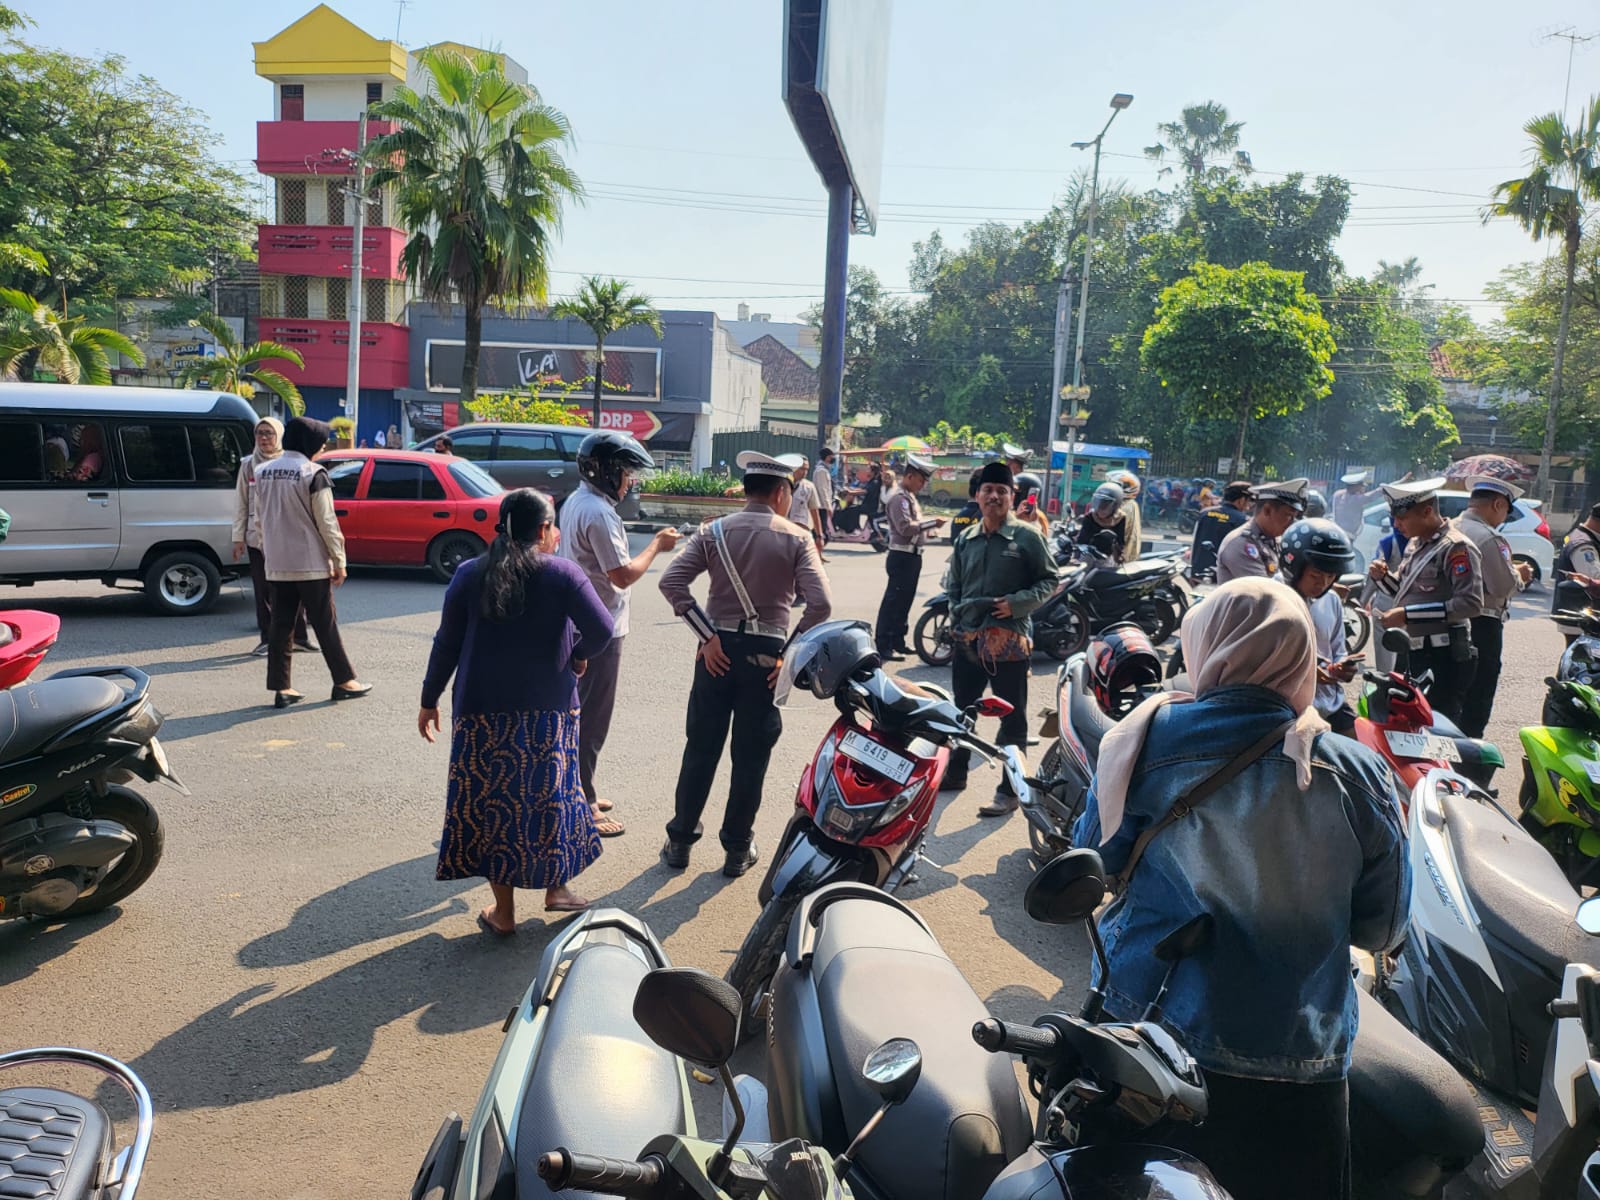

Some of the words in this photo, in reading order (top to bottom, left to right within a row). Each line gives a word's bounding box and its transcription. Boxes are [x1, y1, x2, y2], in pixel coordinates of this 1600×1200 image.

[845, 731, 858, 745] M
[863, 741, 889, 761] 6419
[3, 785, 31, 802] Castrol
